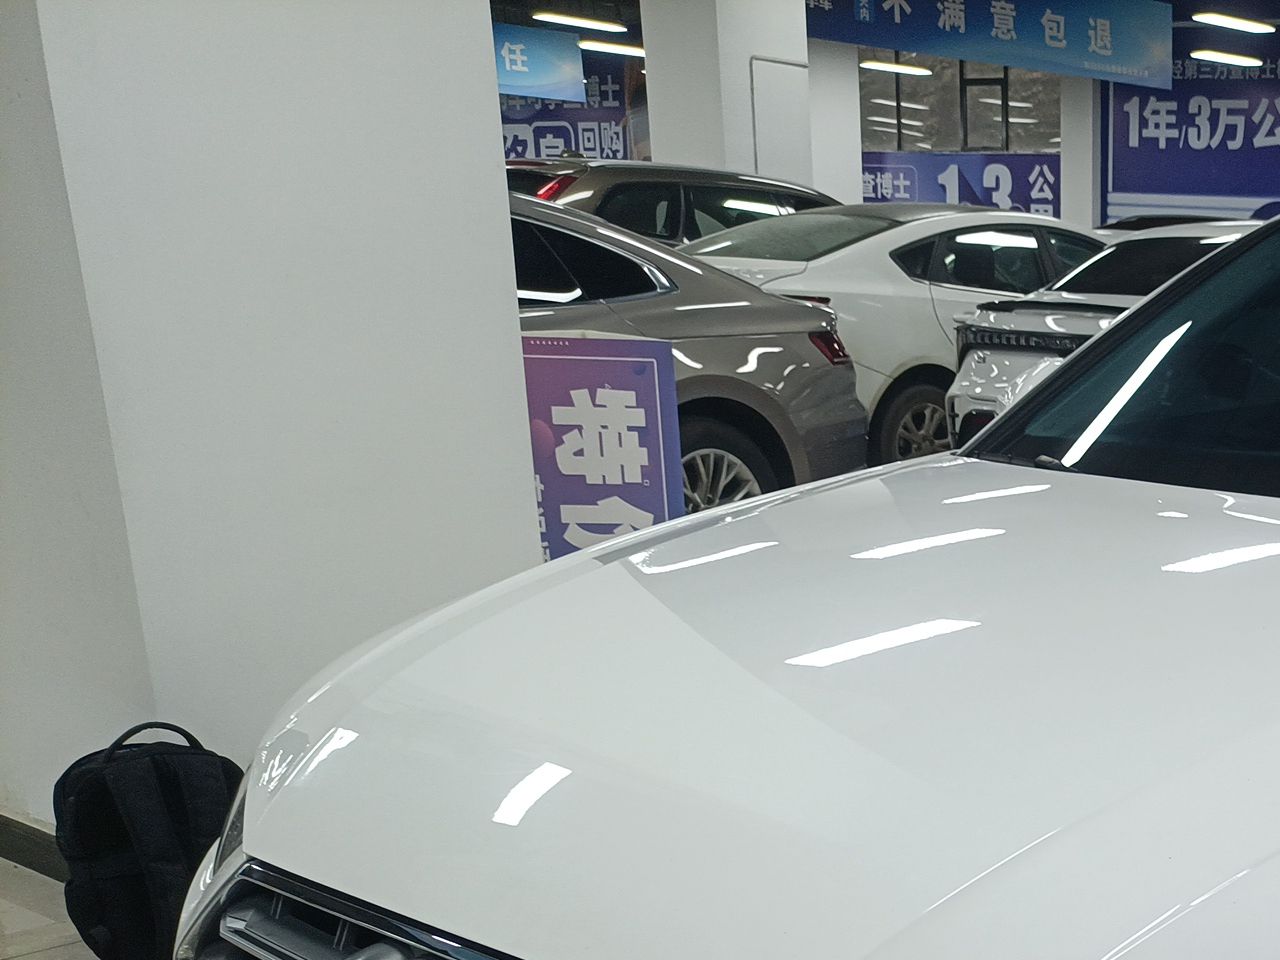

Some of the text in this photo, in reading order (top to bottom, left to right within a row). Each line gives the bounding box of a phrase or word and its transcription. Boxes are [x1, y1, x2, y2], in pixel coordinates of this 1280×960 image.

[882, 0, 1112, 56] 不满意包退
[501, 40, 529, 72] 任
